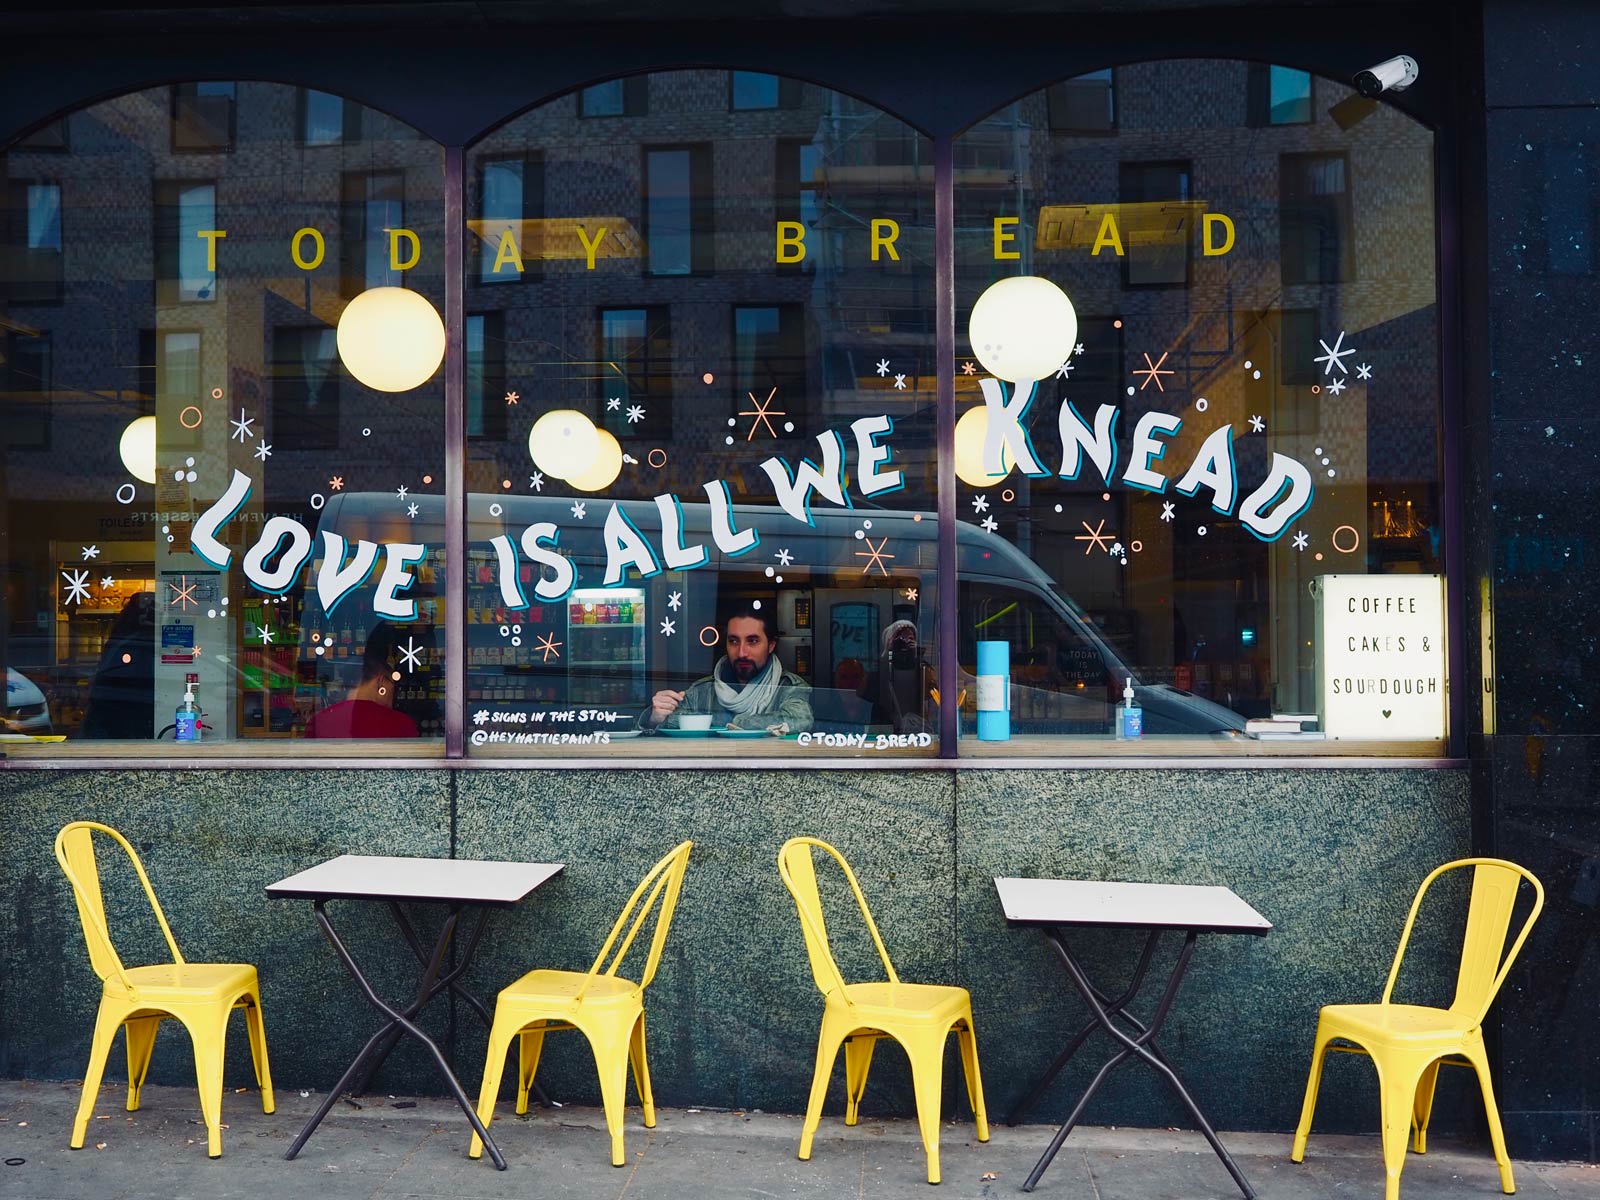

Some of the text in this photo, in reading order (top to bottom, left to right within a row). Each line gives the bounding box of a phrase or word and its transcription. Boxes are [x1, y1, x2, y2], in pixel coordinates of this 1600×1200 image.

[197, 213, 1237, 274] TODAY BREAD
[190, 378, 1315, 622] LOVE IS ALL WE KNEAD
[1348, 597, 1417, 614] COFFEE
[1348, 636, 1431, 652] CAKES &
[1069, 650, 1098, 659] TODAY
[1065, 671, 1101, 679] THE DAY
[1333, 678, 1436, 694] SOURDOUGH
[530, 711, 546, 722] IN
[549, 710, 575, 722] THE
[578, 709, 617, 723] STOW
[471, 729, 611, 747] @HEYHATTIEPAINTS
[797, 732, 932, 750] @TODAY_BREAD
